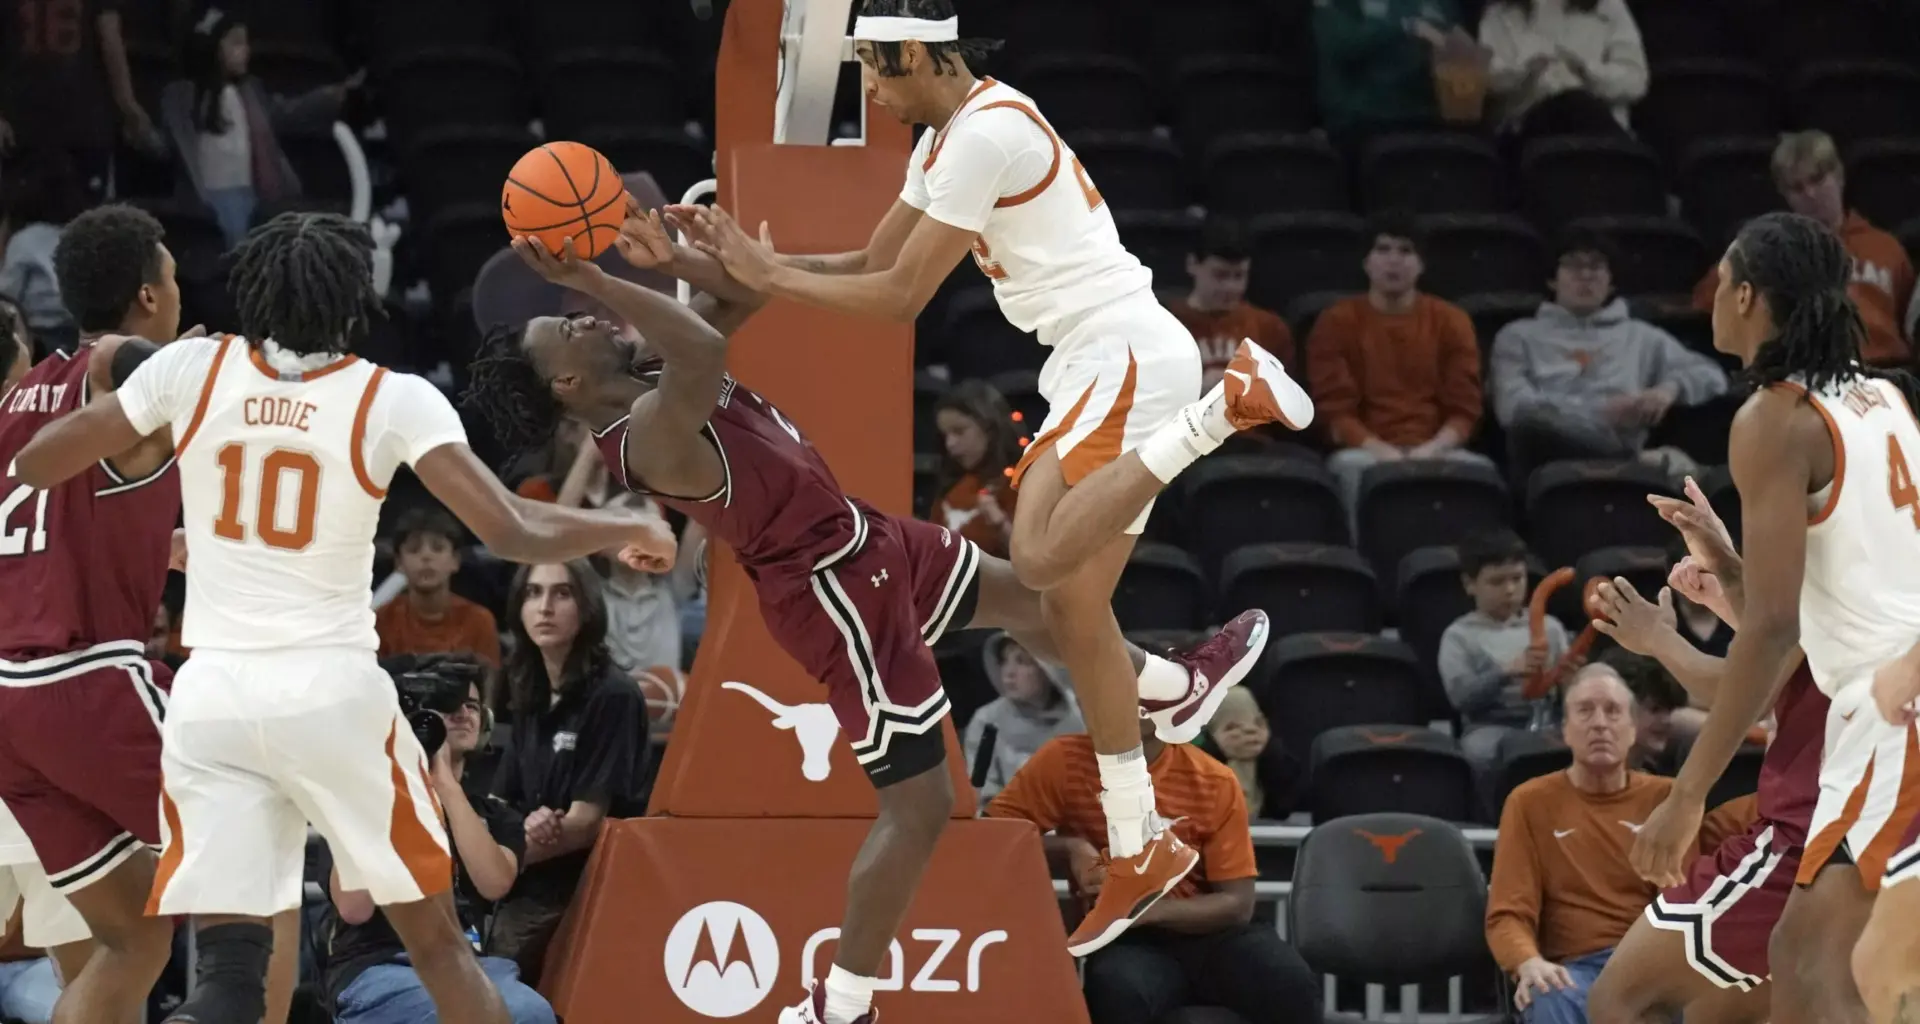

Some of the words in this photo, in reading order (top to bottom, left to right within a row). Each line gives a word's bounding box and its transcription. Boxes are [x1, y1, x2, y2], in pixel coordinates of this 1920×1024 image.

[244, 397, 317, 432] CODIE
[0, 458, 49, 556] 21
[212, 440, 325, 553] 10
